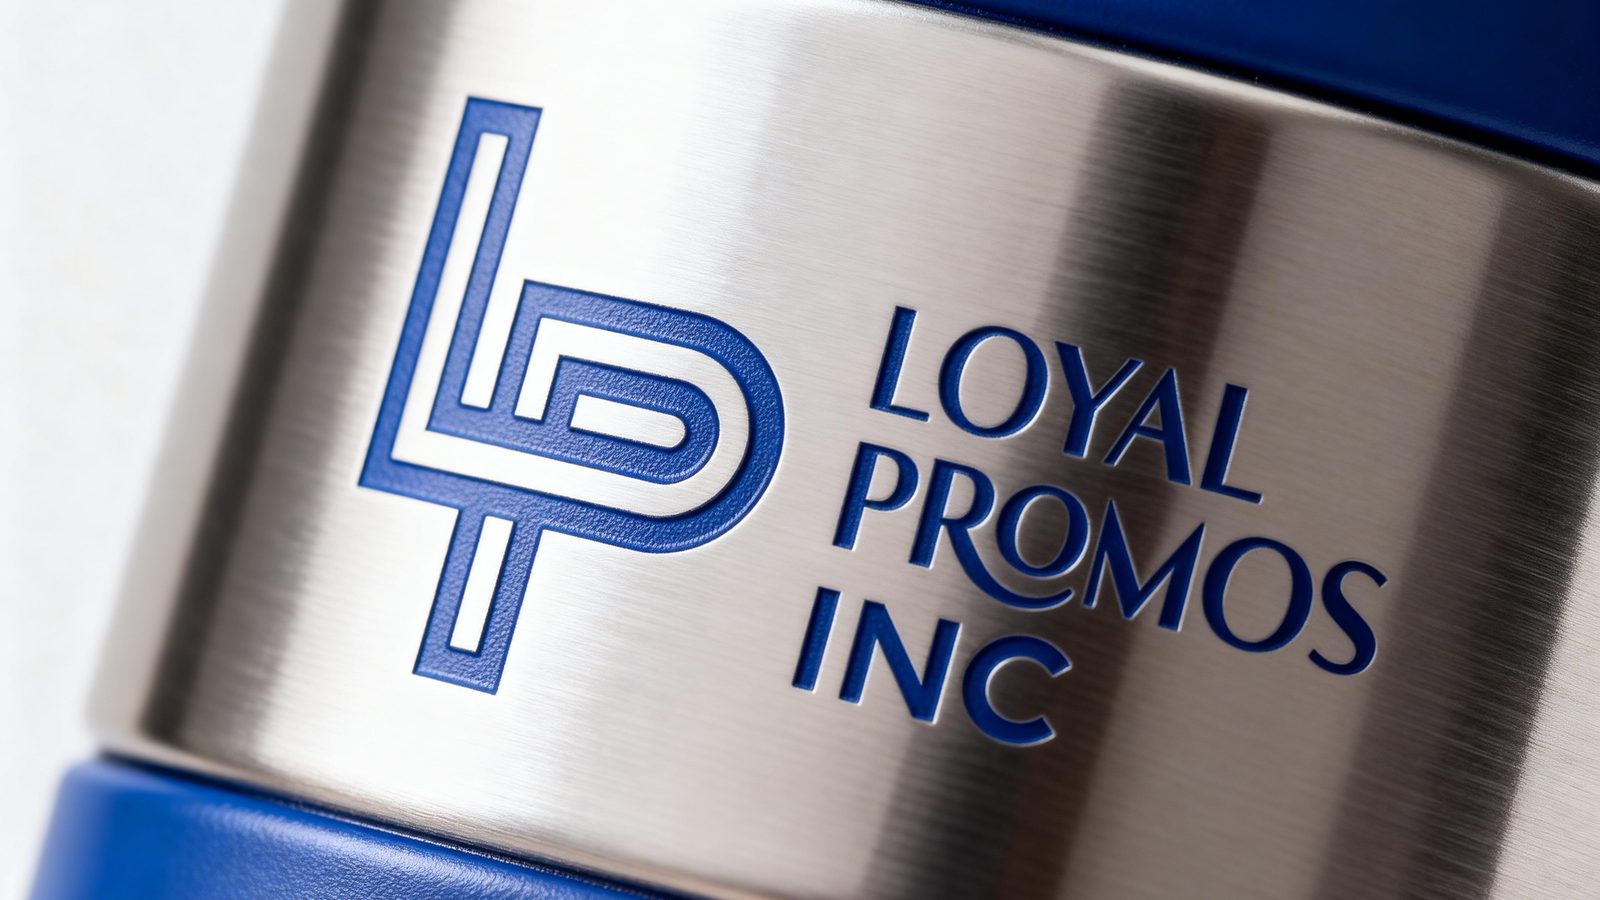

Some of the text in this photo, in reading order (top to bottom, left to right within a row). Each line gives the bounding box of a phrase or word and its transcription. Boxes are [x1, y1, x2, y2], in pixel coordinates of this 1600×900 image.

[868, 305, 1264, 504] LOYAL
[833, 442, 1387, 677] PROMOS
[793, 586, 1073, 747] INC
